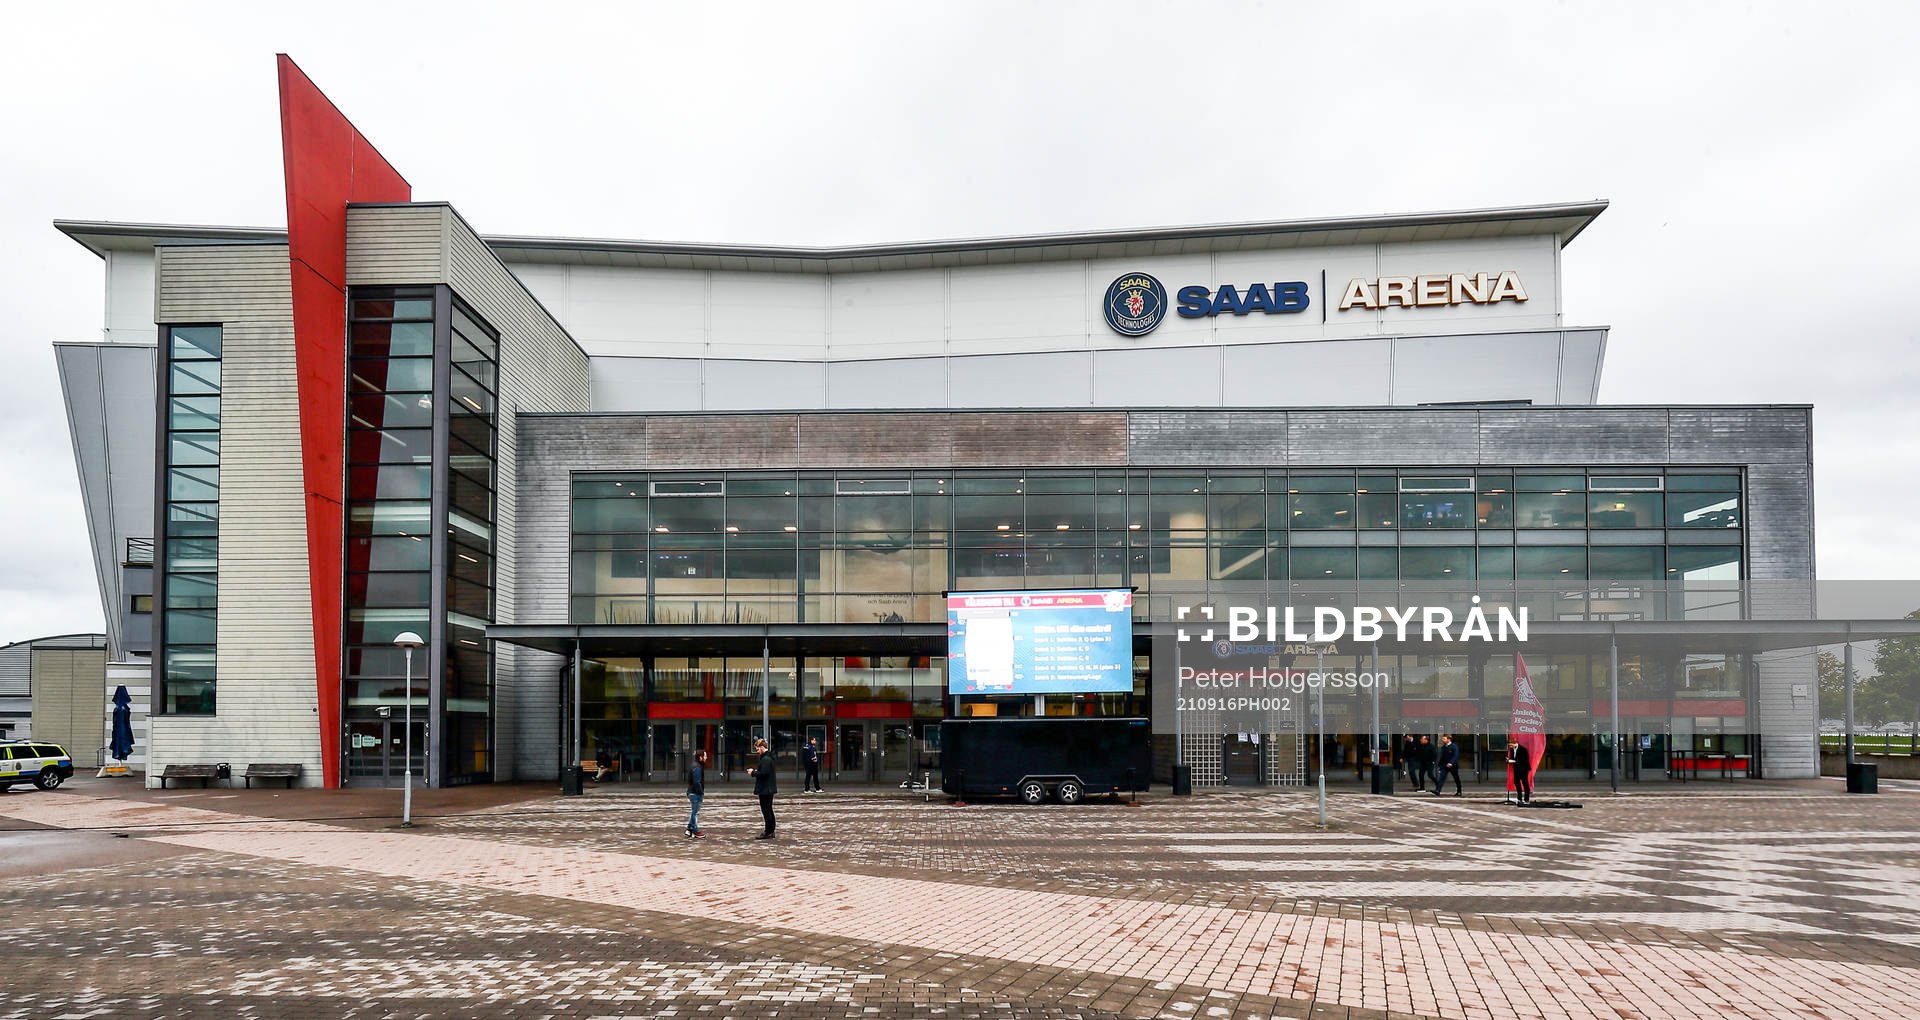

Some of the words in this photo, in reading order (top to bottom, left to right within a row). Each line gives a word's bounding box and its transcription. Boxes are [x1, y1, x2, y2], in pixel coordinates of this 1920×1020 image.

[1120, 278, 1151, 290] SAAB
[1176, 281, 1310, 319] SAAB
[1338, 270, 1529, 311] ARENA
[1117, 313, 1155, 329] TECHNOLOGIES
[1235, 644, 1276, 655] SAAB
[1284, 644, 1339, 655] AREA
